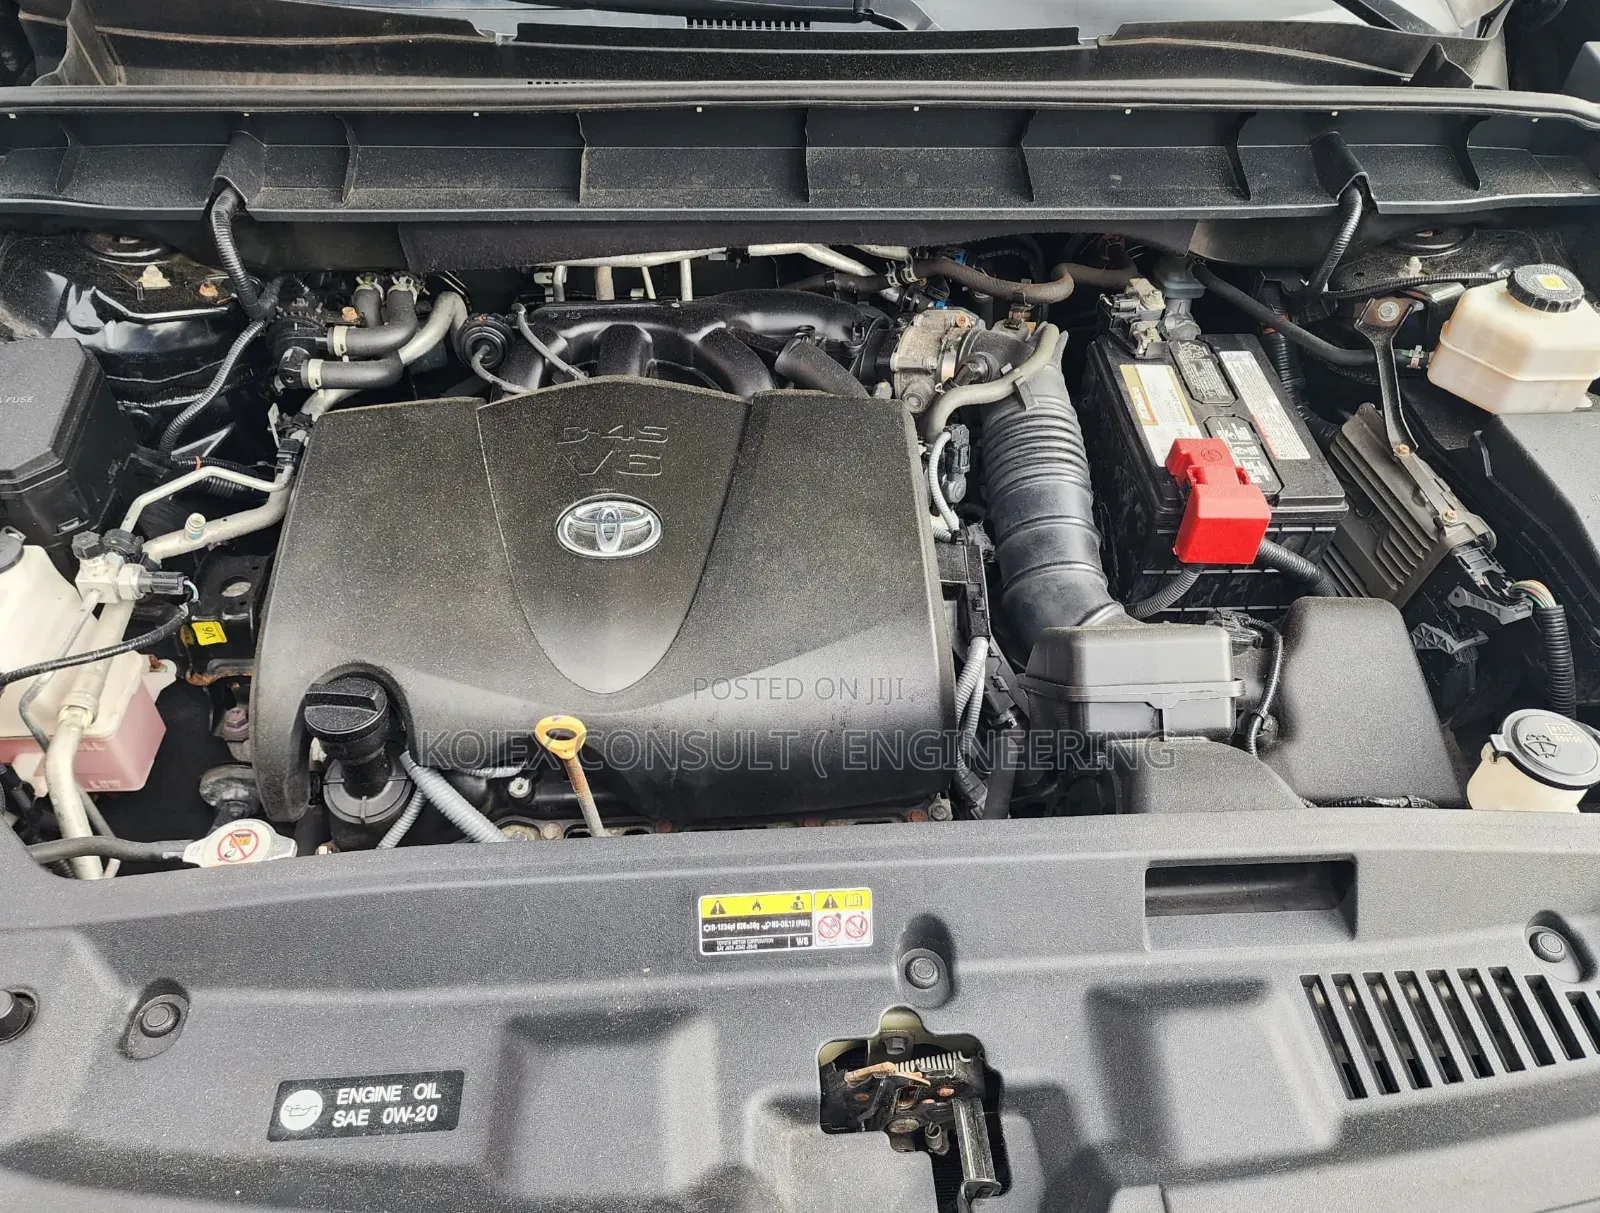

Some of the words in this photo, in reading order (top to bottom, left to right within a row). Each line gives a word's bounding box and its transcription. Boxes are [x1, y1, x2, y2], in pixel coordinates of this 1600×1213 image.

[5, 396, 34, 404] FUSE
[202, 626, 216, 639] V6
[89, 780, 121, 789] LOW
[796, 936, 809, 946] WS
[336, 1084, 403, 1105] ENGINE
[413, 1082, 442, 1100] OIL
[332, 1108, 370, 1128] SAE
[382, 1104, 438, 1125] 0W-20
